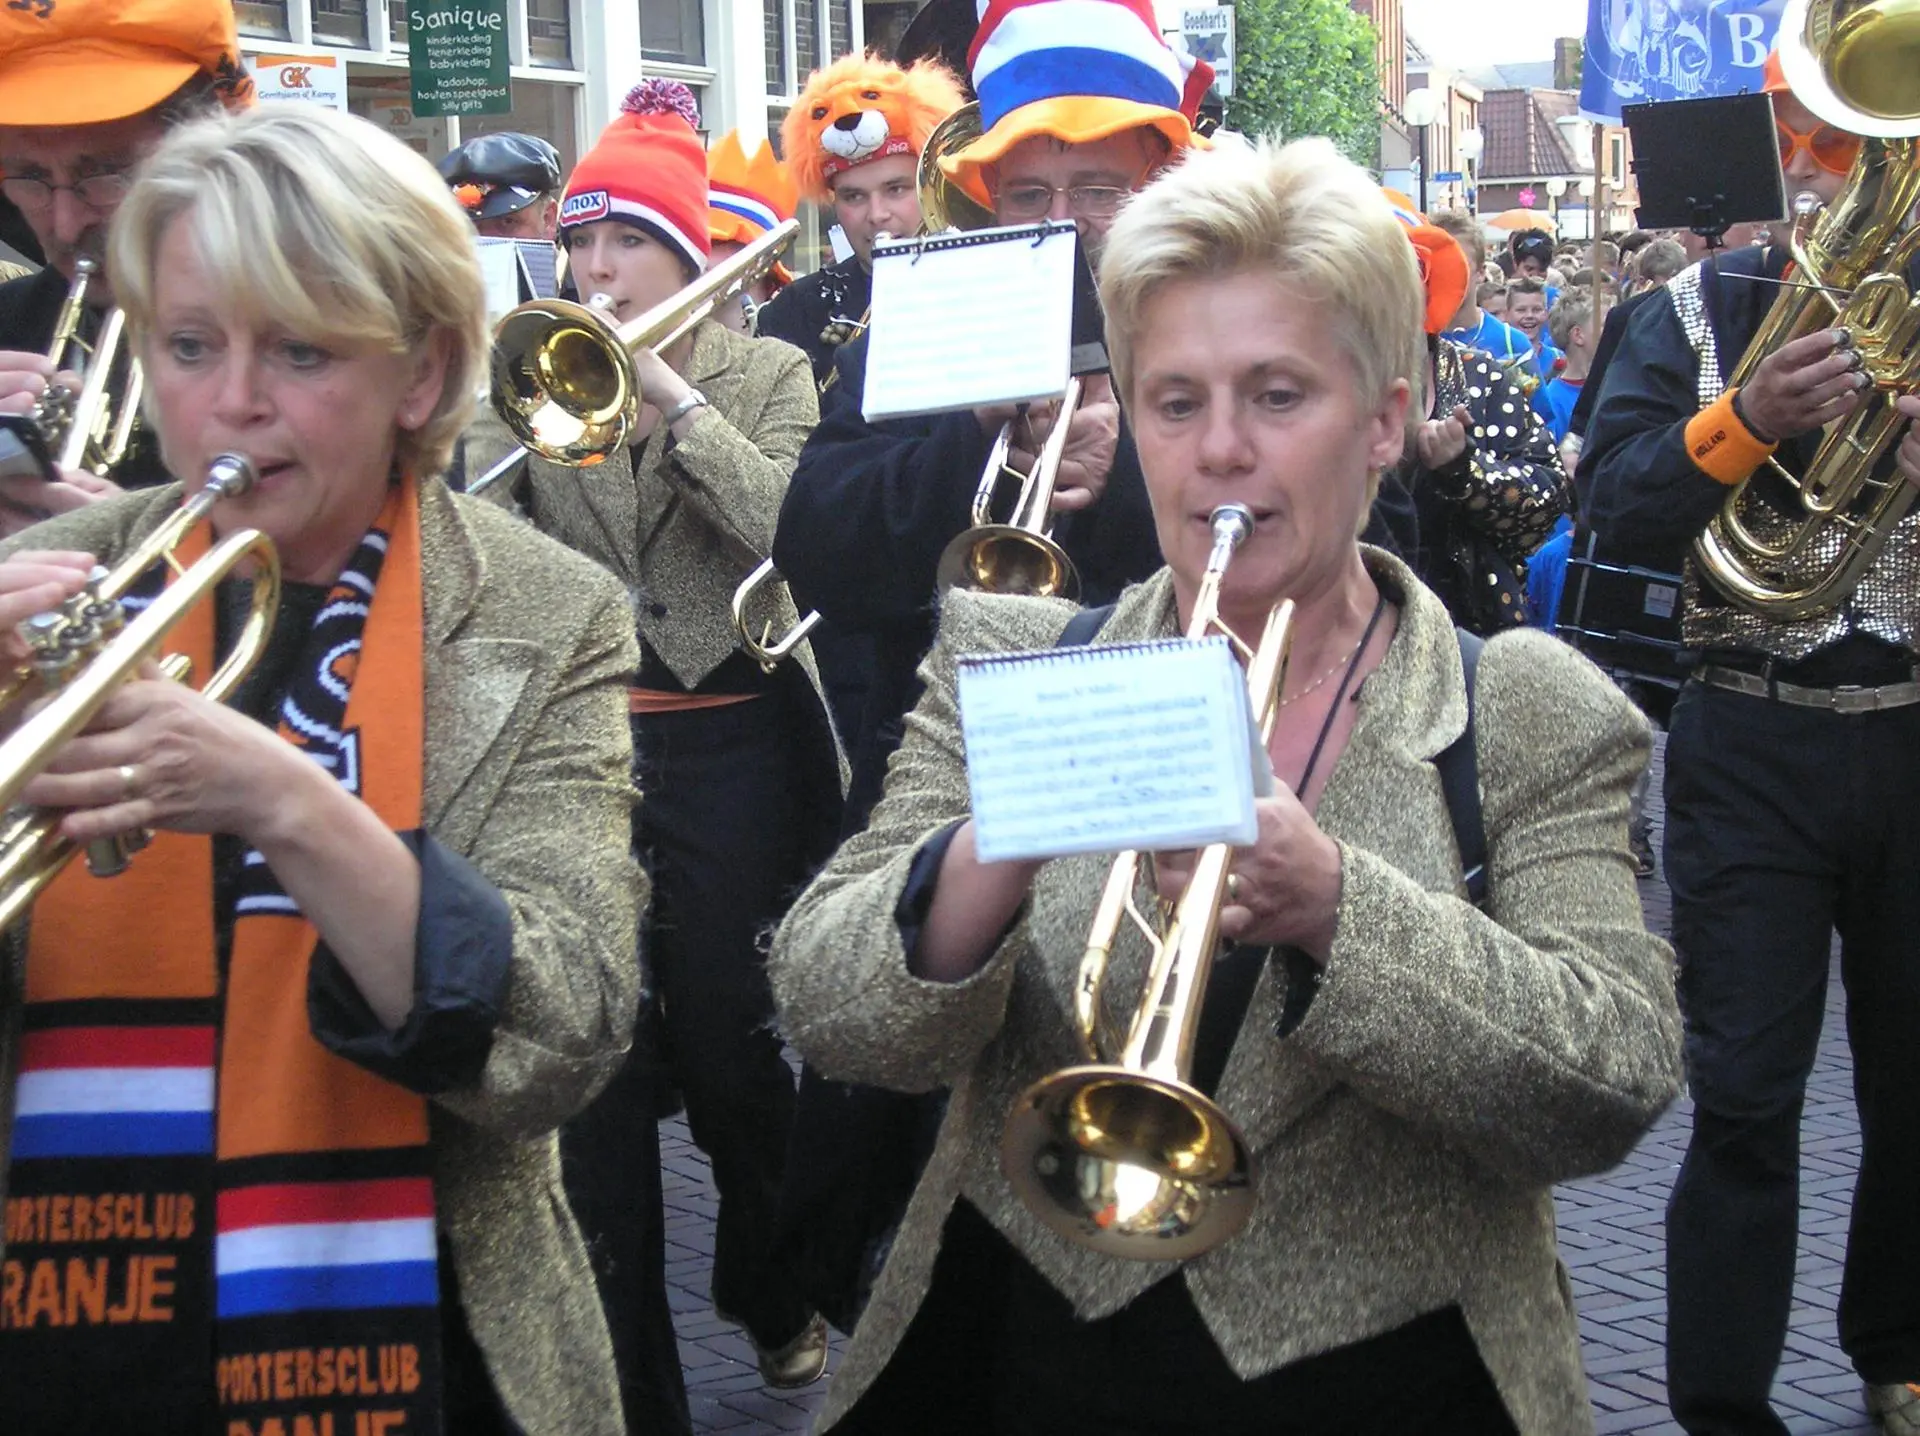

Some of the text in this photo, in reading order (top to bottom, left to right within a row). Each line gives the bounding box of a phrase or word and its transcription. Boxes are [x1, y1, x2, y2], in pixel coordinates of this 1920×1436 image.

[411, 5, 502, 31] Sanique
[426, 34, 492, 45] kinderkleding
[428, 46, 492, 57] tienerkleding
[429, 58, 491, 69] babykleding
